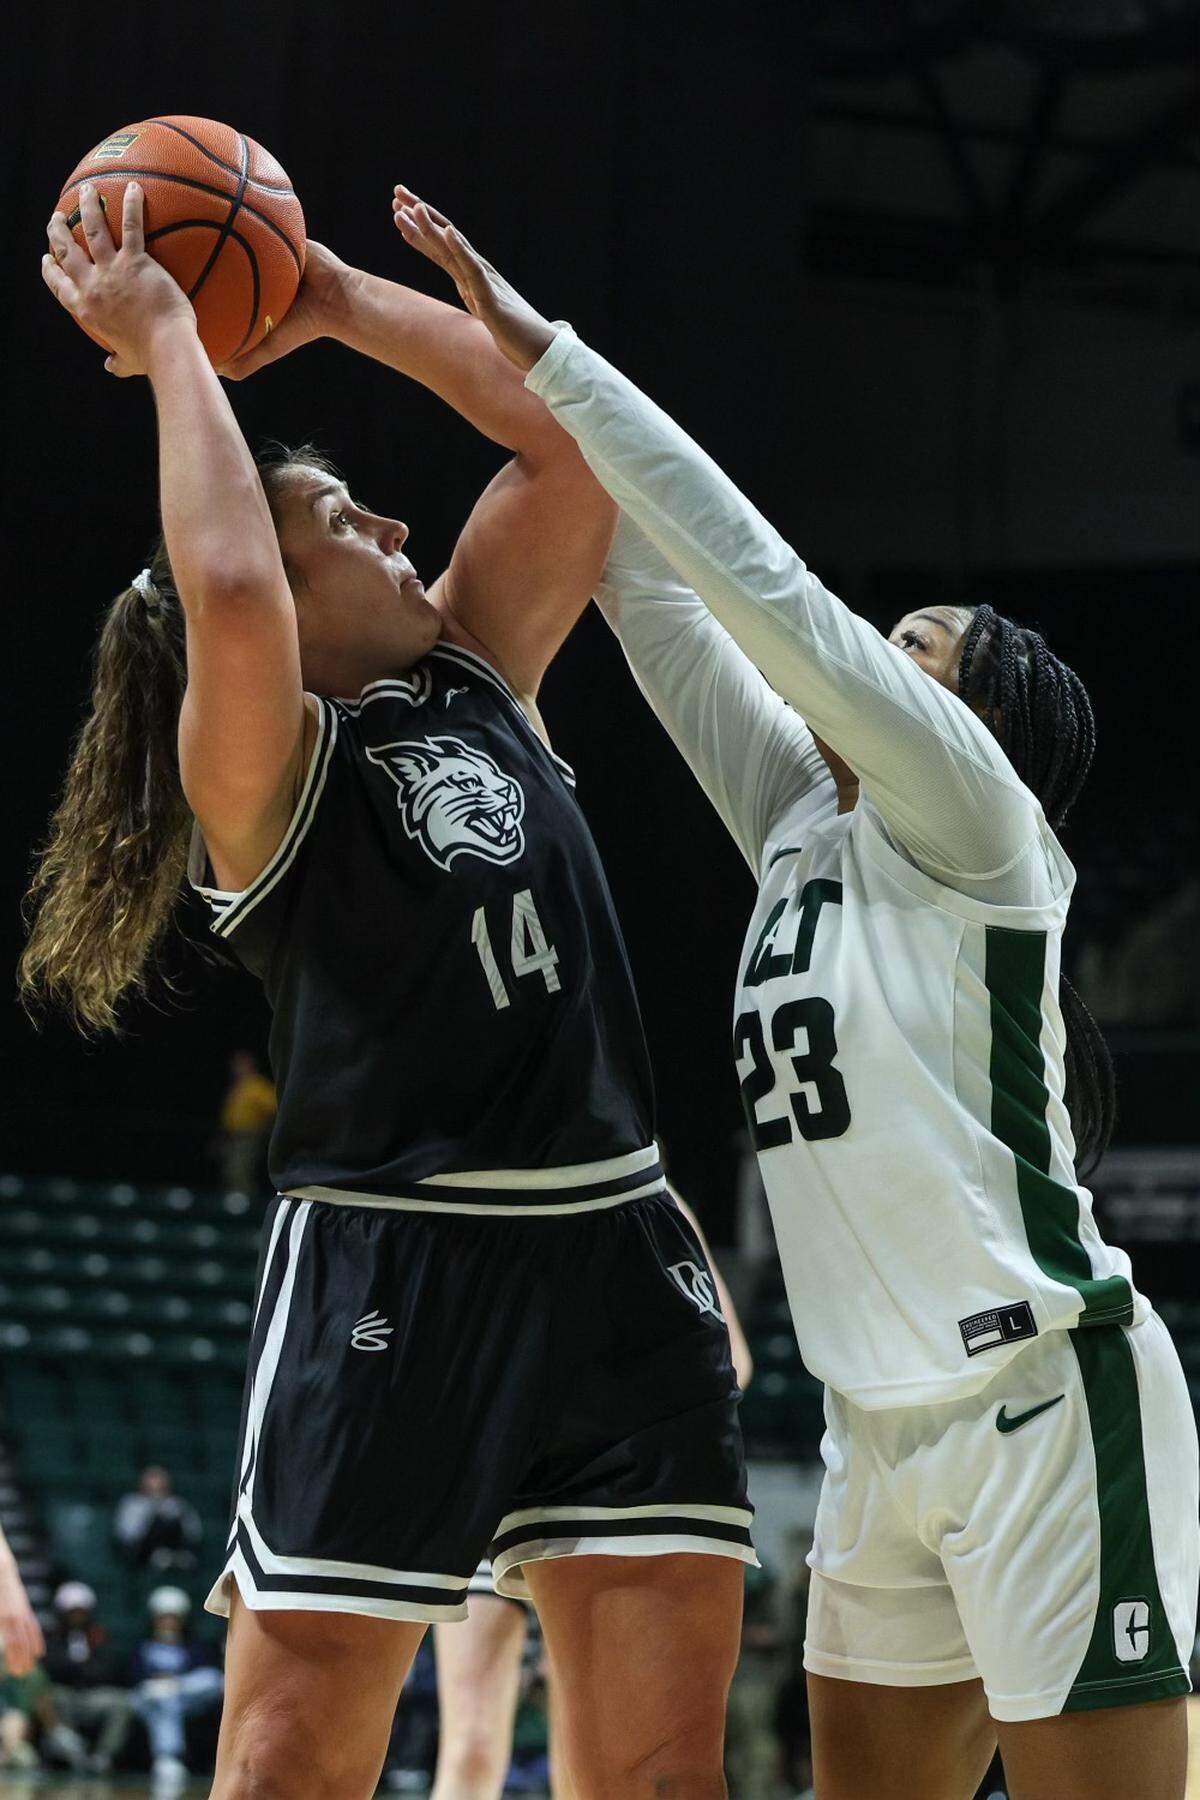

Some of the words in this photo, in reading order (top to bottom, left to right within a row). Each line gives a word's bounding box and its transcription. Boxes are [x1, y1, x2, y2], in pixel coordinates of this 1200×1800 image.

[471, 888, 562, 1010] 14
[734, 997, 851, 1152] 23
[1009, 1316, 1021, 1330] L
